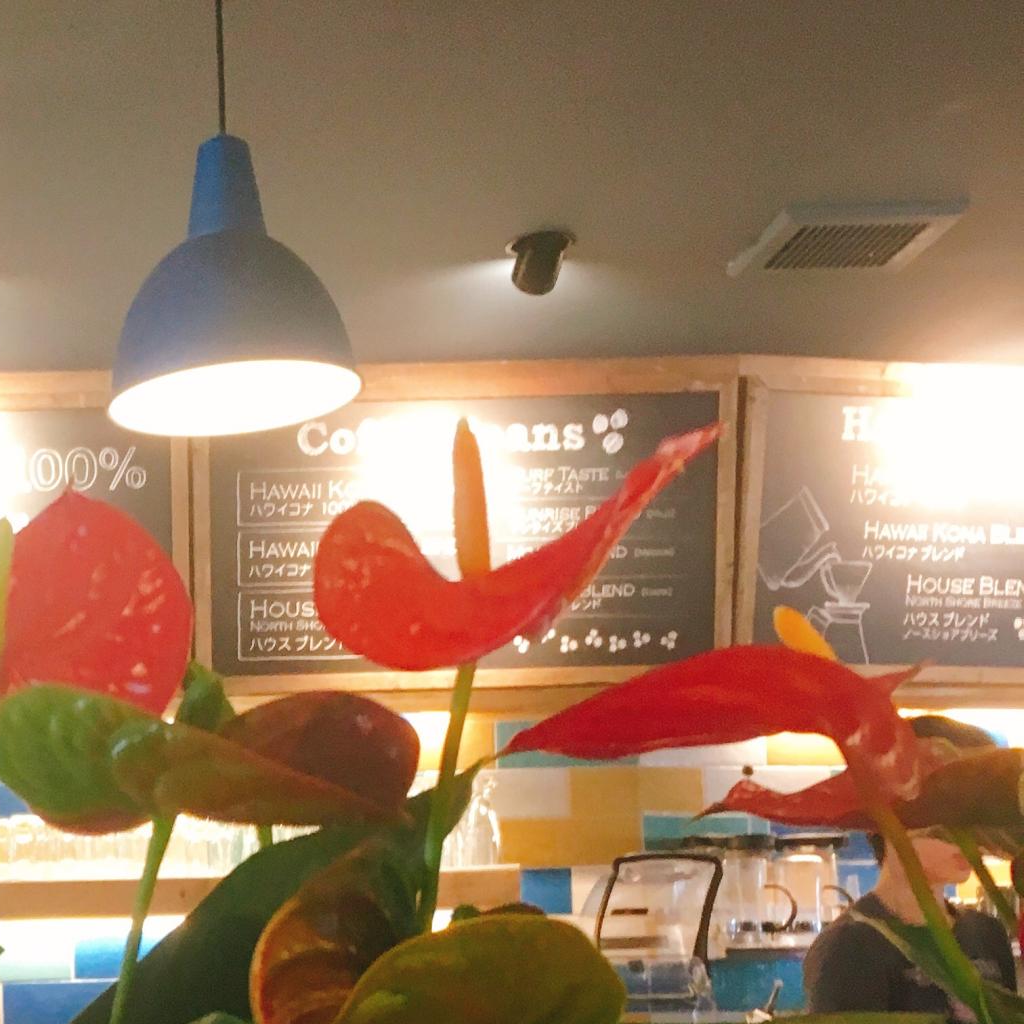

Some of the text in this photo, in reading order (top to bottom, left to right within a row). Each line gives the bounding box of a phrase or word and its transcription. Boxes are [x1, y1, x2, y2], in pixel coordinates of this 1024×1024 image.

[32, 446, 147, 490] 00%
[559, 466, 609, 482] TASTE
[249, 481, 322, 501] HAWAII
[249, 501, 314, 518] ハワイコナ
[249, 563, 312, 578] ハワイコナ
[905, 574, 1024, 597] HOUSE BLEN
[250, 600, 320, 619] HOUS
[249, 634, 344, 652] ハウス ブレン
